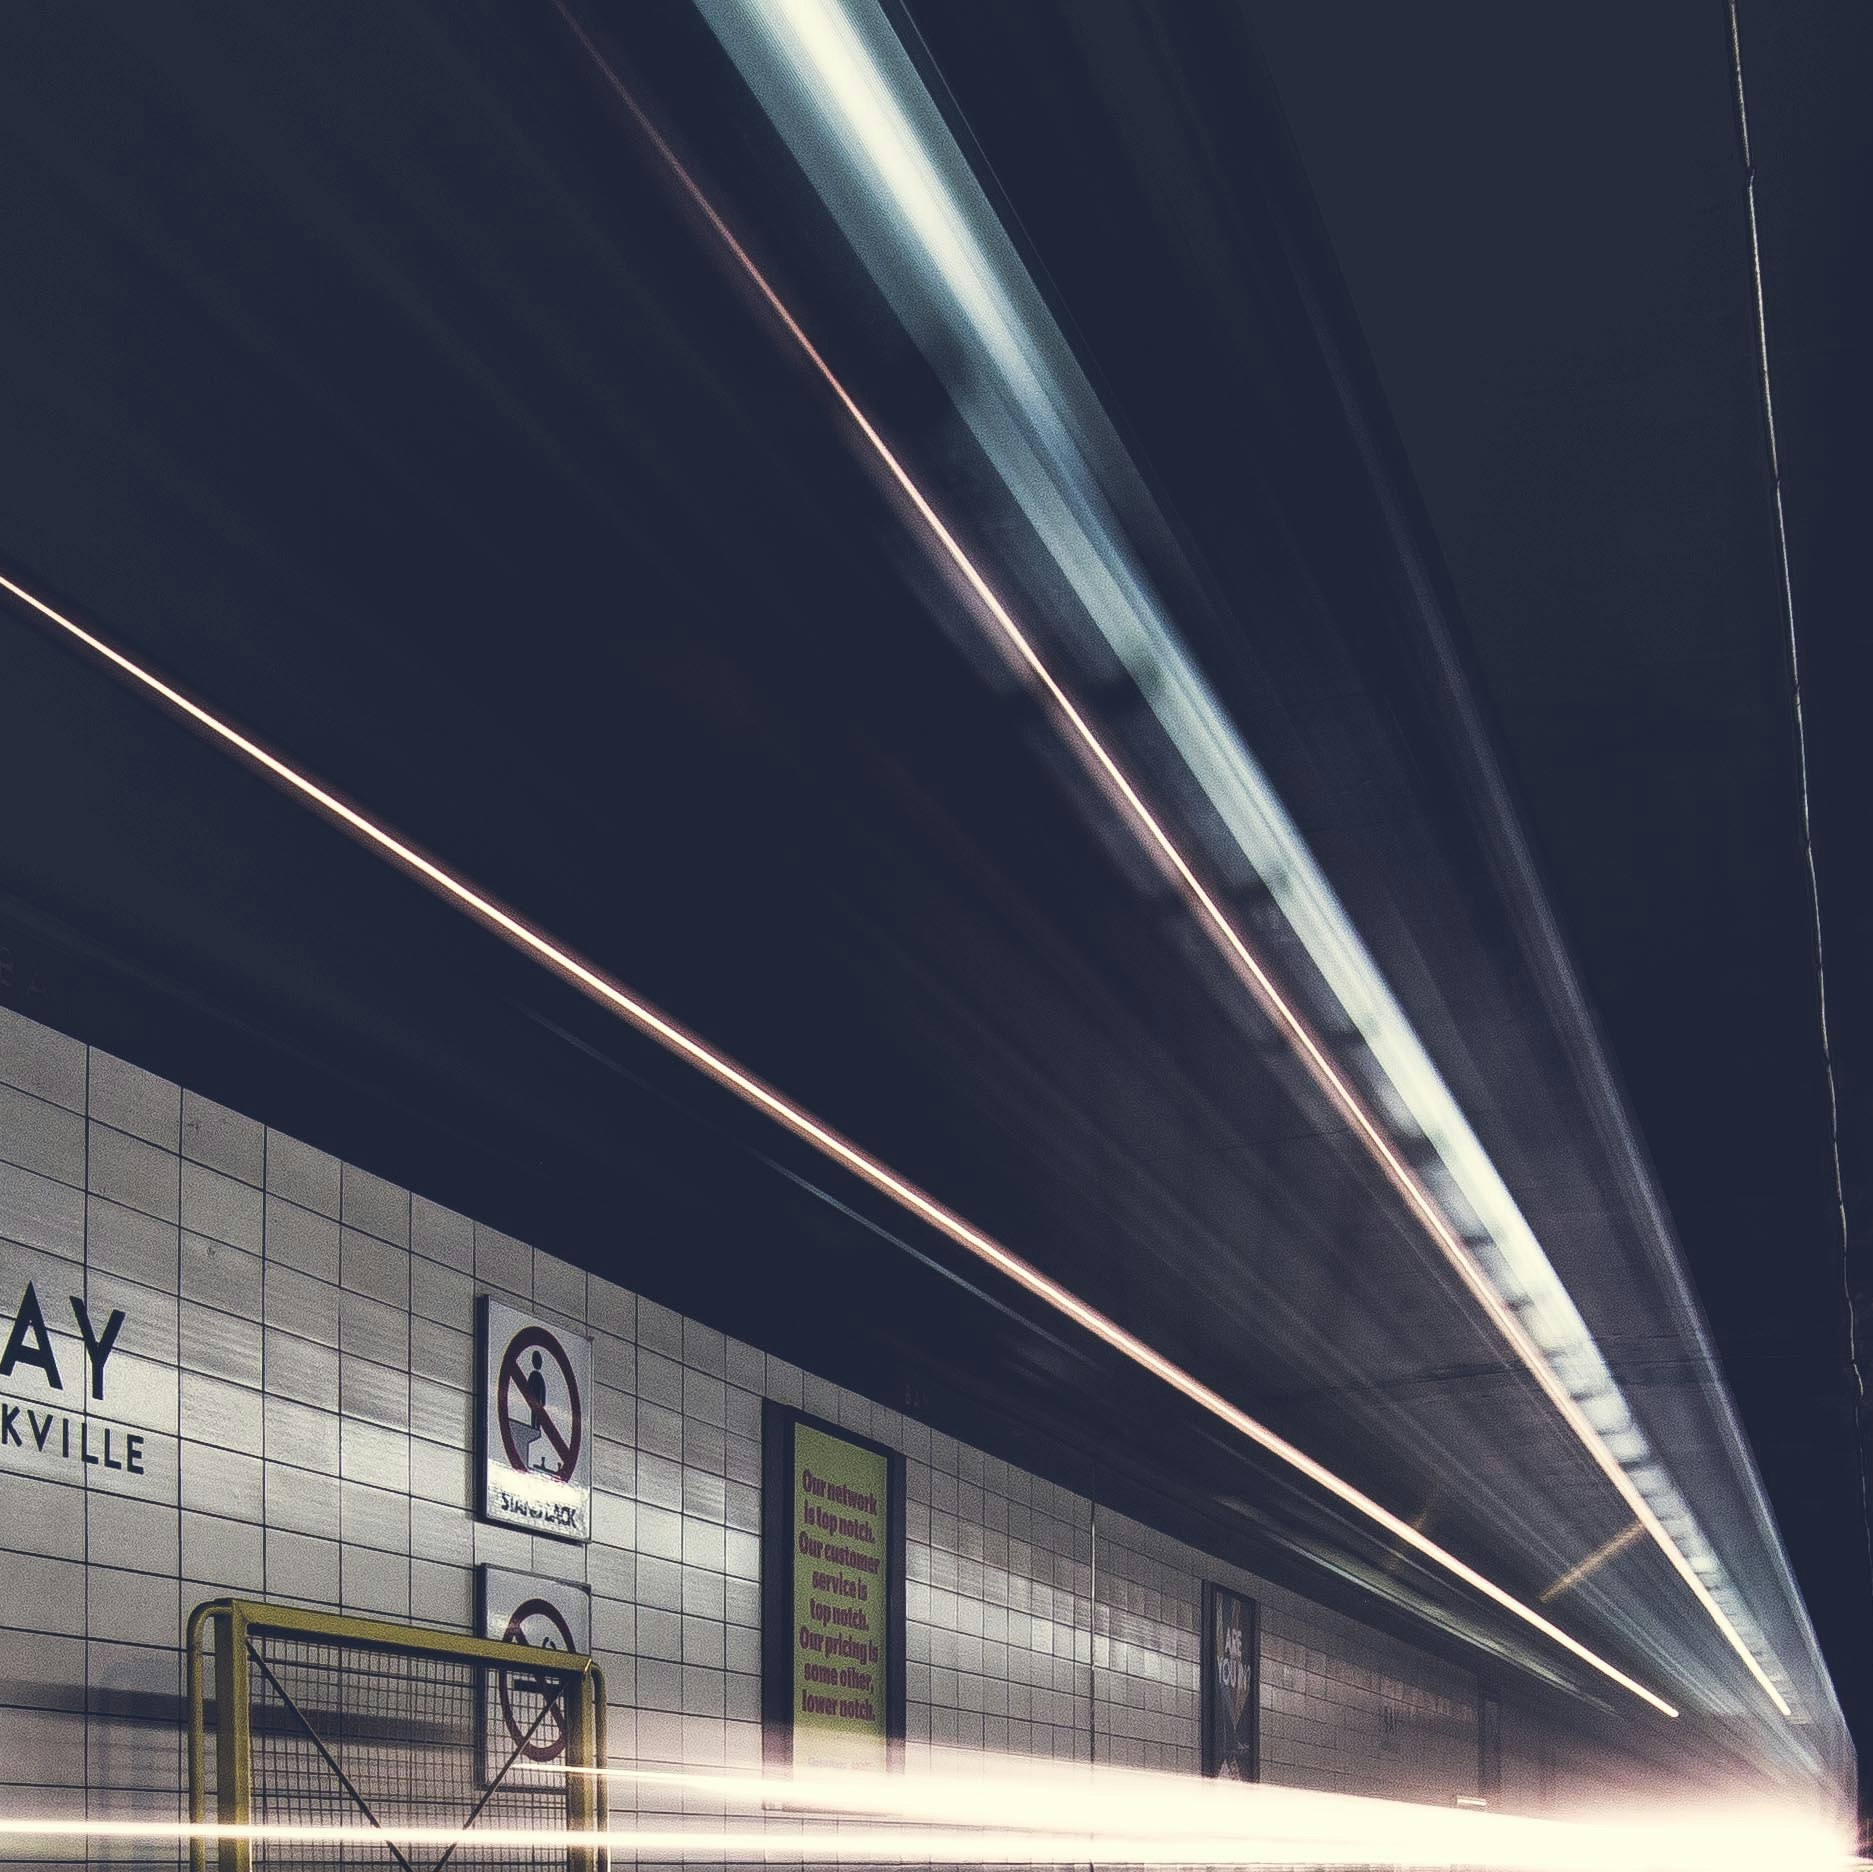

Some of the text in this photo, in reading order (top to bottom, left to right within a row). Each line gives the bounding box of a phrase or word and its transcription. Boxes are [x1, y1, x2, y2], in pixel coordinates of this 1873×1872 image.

[802, 1467, 878, 1517] Our network
[804, 1498, 876, 1545] is top notch.
[799, 1530, 881, 1575] Our customer
[812, 1571, 869, 1602] service is
[810, 1597, 870, 1633] top notch.
[799, 1625, 824, 1653] Our
[824, 1631, 866, 1666] pricing
[804, 1662, 838, 1687] some
[802, 1688, 876, 1723] lower notch.
